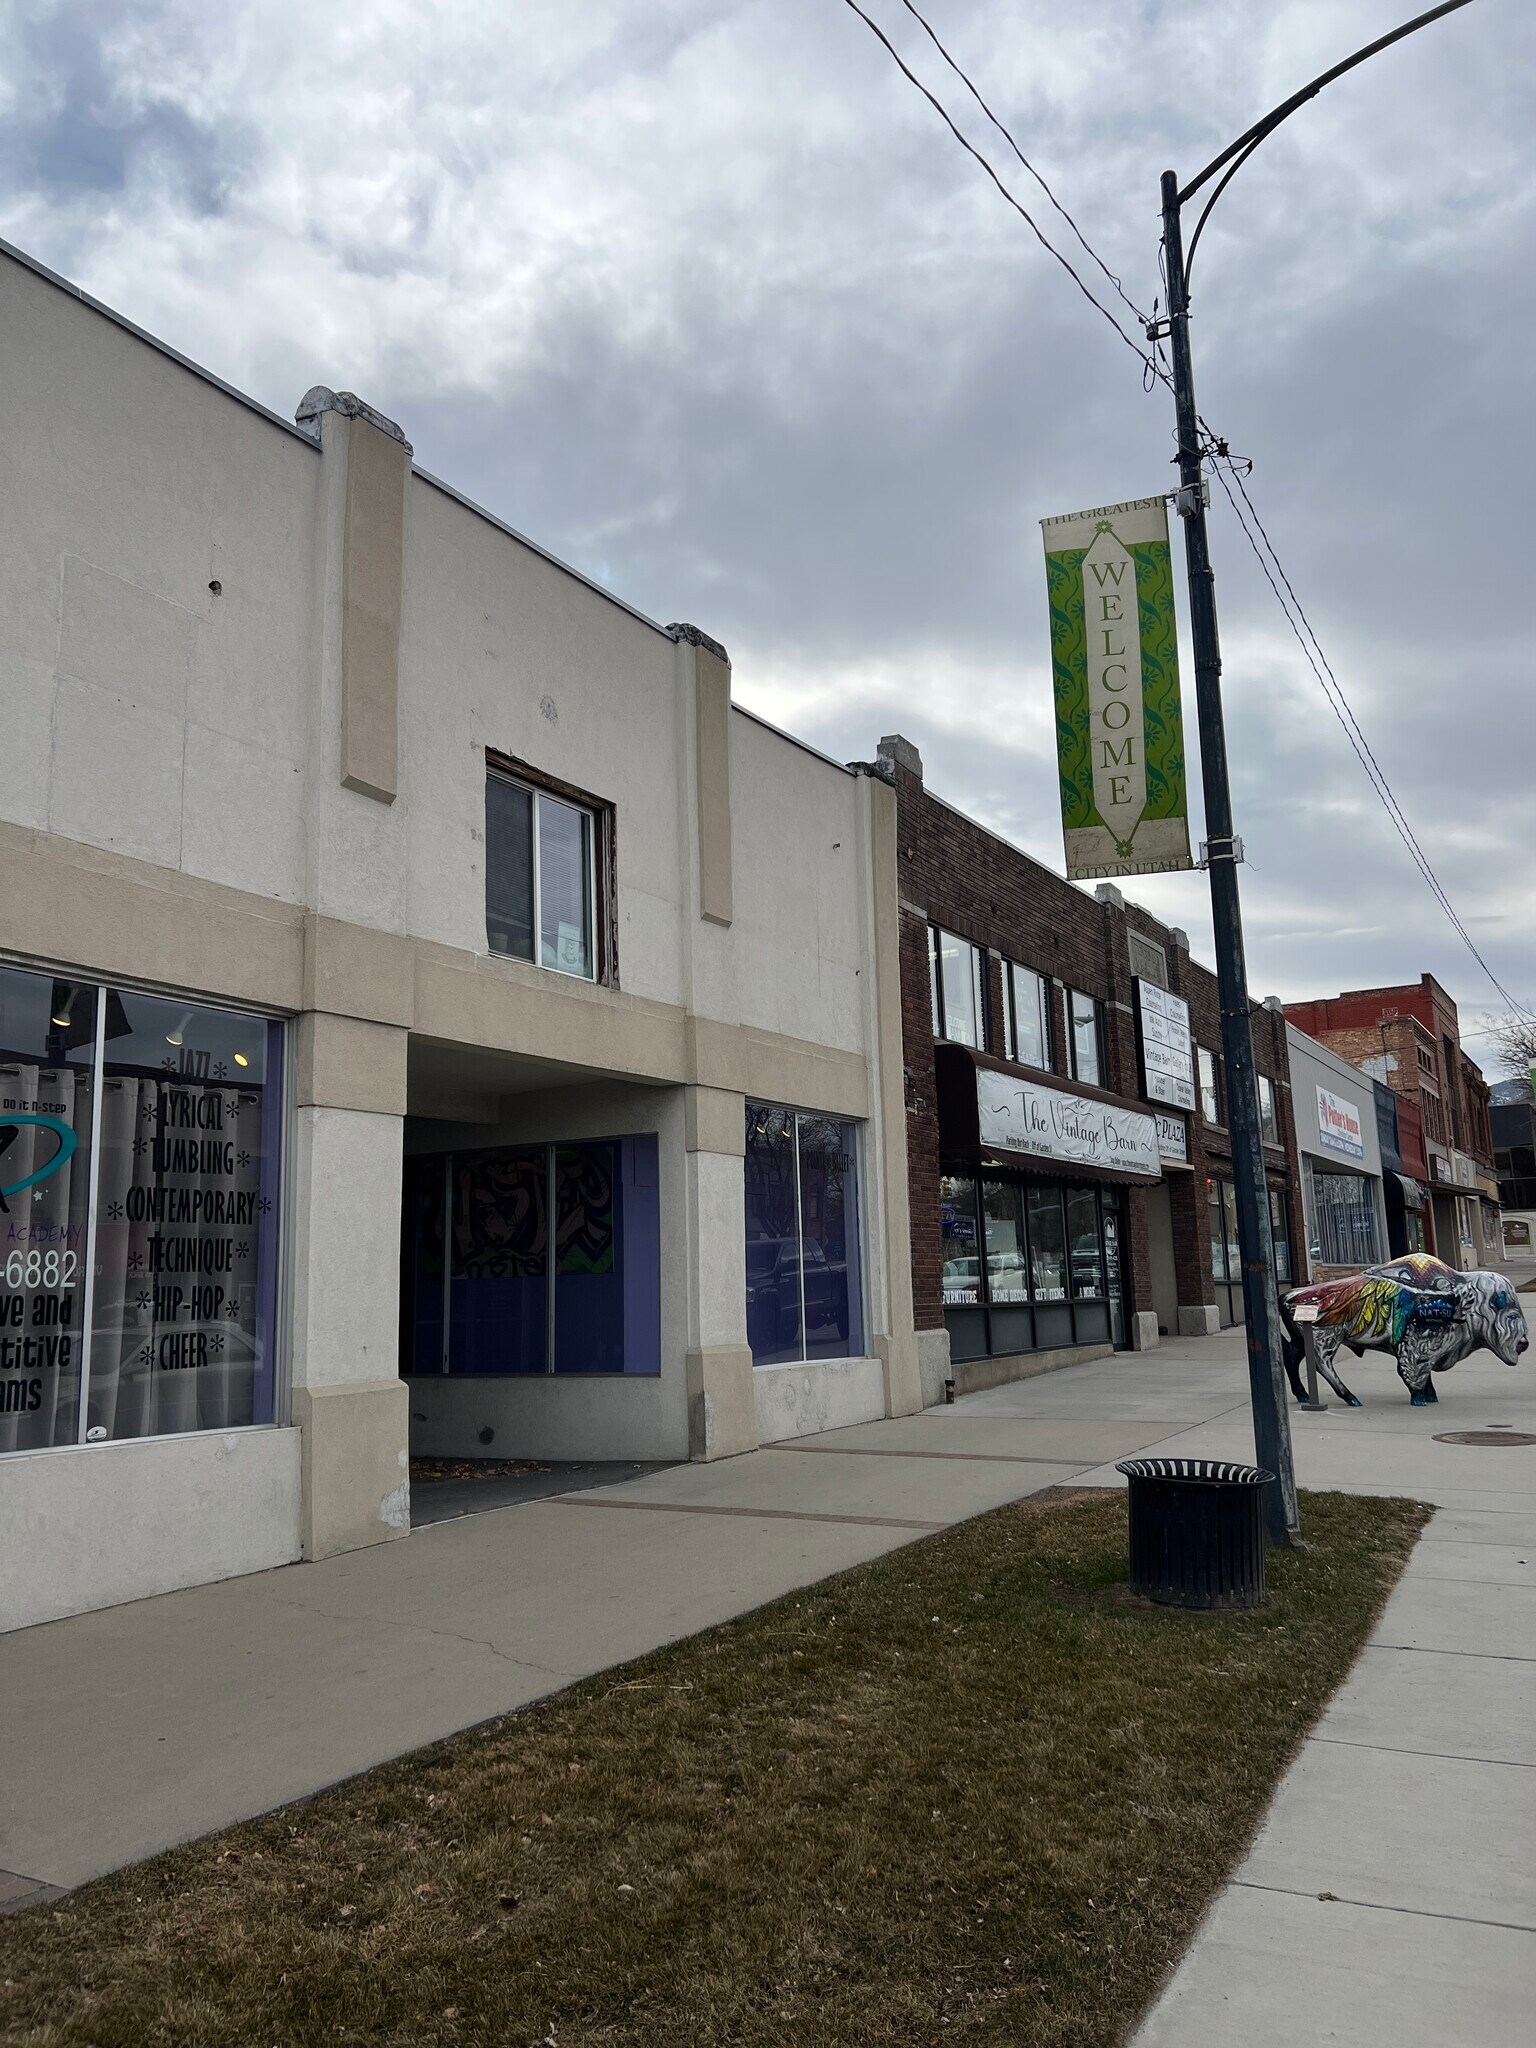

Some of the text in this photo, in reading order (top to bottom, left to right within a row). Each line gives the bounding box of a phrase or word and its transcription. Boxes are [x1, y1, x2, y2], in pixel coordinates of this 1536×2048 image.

[1046, 496, 1163, 526] THE GREATEST
[1088, 561, 1137, 806] WELCOME
[1075, 860, 1180, 879] CITY IN UTAH
[19, 1100, 29, 1111] it
[163, 1092, 223, 1130] LYRICAL
[1014, 1091, 1138, 1155] The Vintage Barn
[150, 1138, 234, 1175] TUMBLING
[126, 1186, 256, 1226] CONTEMPORARY
[6, 1223, 83, 1247] ACADEMY
[147, 1236, 233, 1274] TECHNIQUE
[32, 1294, 72, 1326] and
[154, 1285, 225, 1322] HIP-HOP
[992, 1290, 1008, 1302] HOME
[1009, 1289, 1028, 1302] DECOR
[1034, 1289, 1047, 1301] GIFT
[1083, 1286, 1096, 1297] MORE
[159, 1332, 208, 1371] CHEER
